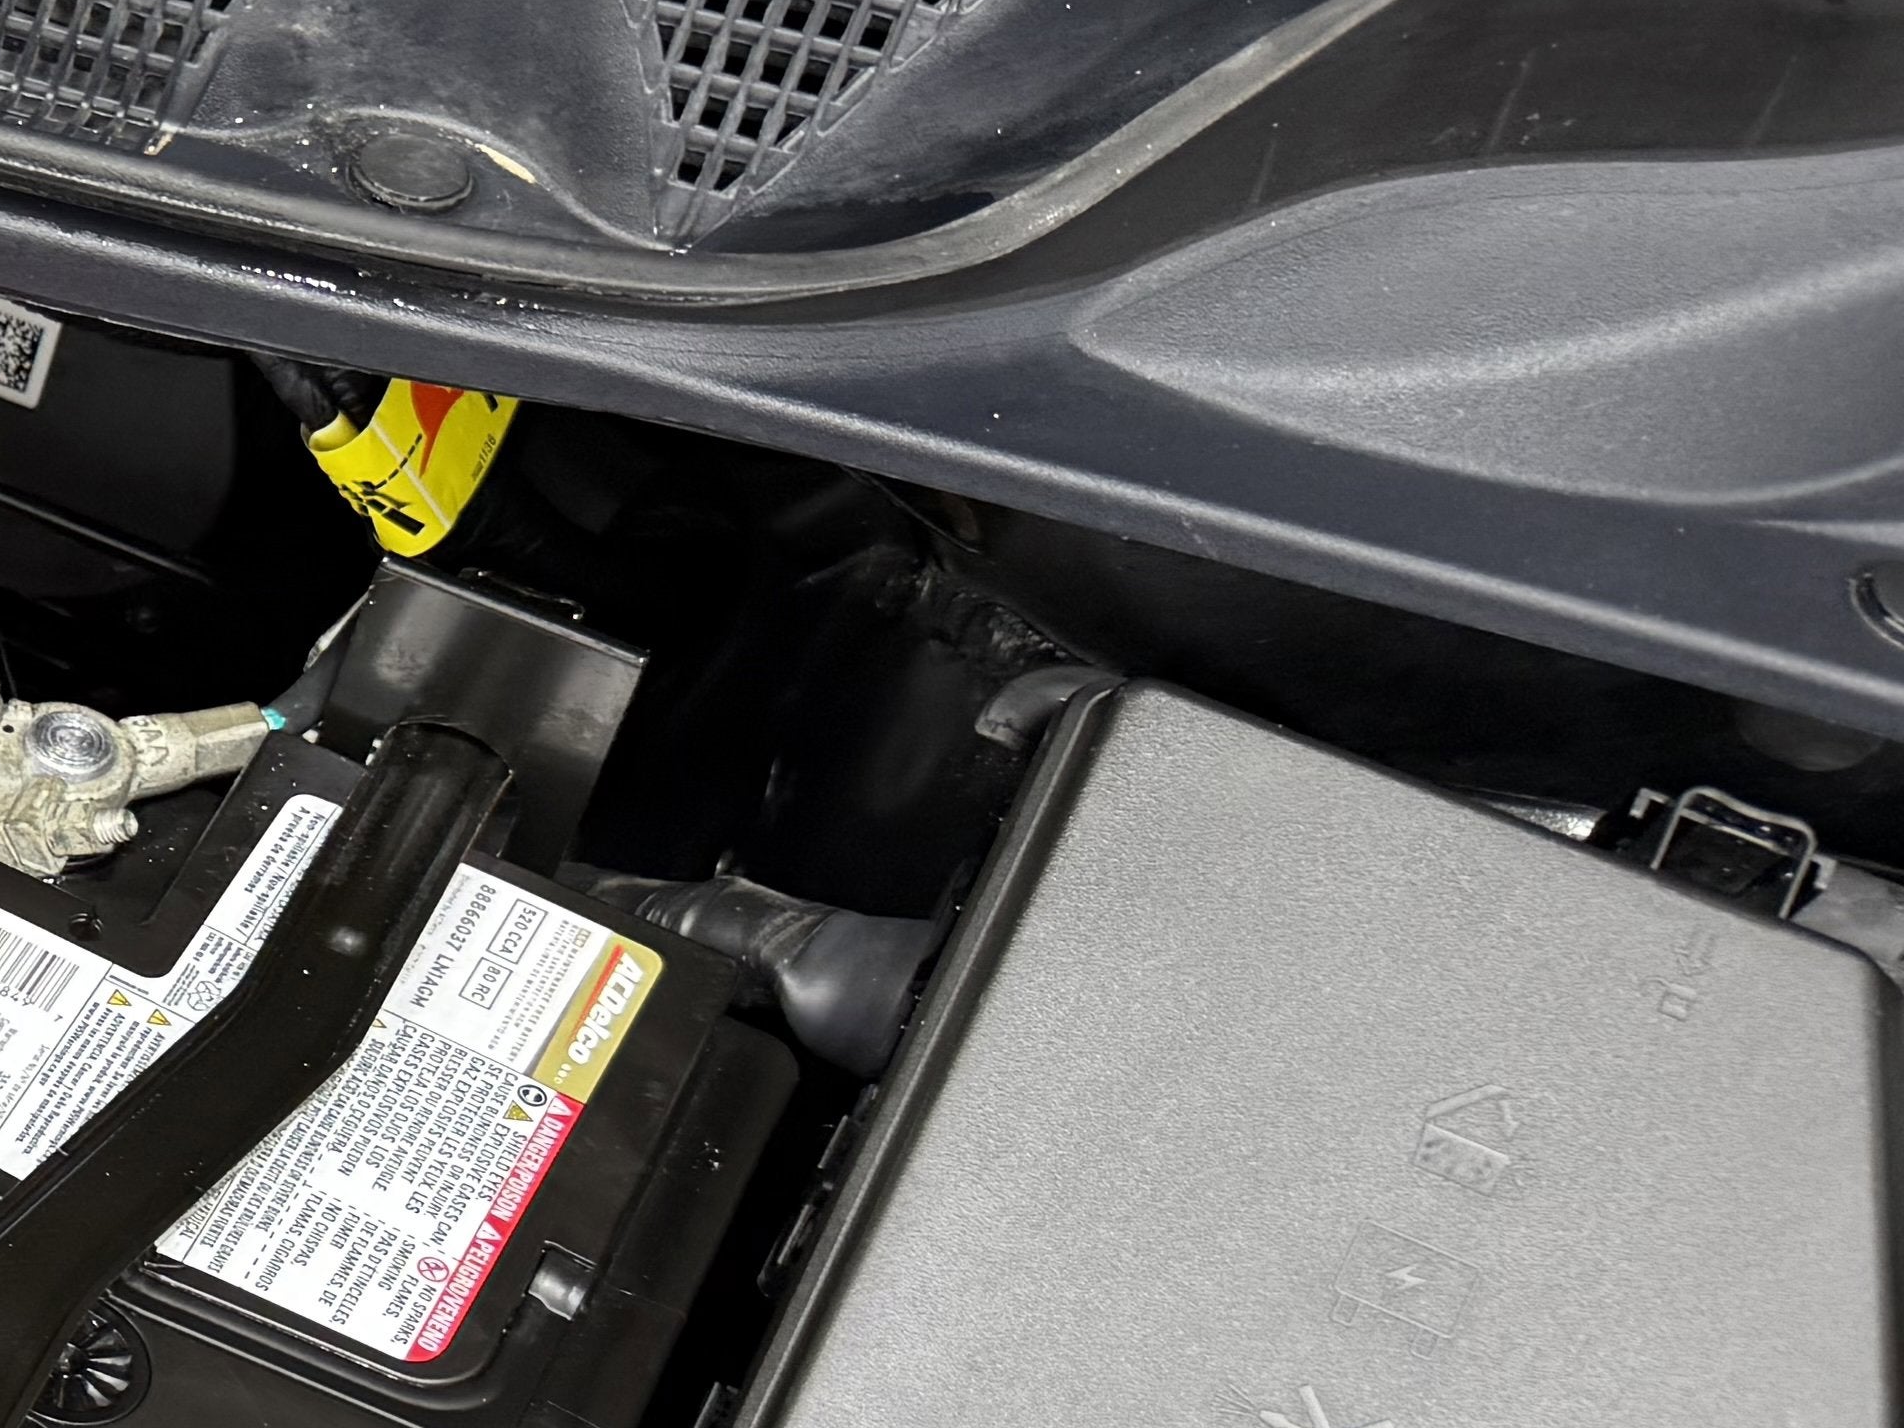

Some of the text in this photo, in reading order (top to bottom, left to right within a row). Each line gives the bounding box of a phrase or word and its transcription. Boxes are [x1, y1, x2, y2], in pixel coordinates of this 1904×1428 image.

[243, 853, 277, 896] derrames
[444, 883, 497, 952] 88866037
[498, 906, 536, 956] 520 CCA
[408, 952, 454, 1009] LN1AGM
[470, 965, 500, 1002] 80 RC
[563, 950, 648, 1069] ACDelco
[382, 1023, 418, 1065] CAUSAR
[402, 1031, 436, 1069] GASES
[411, 1039, 453, 1090] PROTEJA
[432, 1047, 468, 1091] BLESSER
[483, 1063, 503, 1080] SE
[489, 1071, 518, 1106] CAUSE
[355, 1098, 371, 1109] O
[361, 1068, 413, 1136] EXPLOSIVOS
[398, 1088, 423, 1112] LOS
[398, 1055, 486, 1183] GAZ EXPLOSIFS PEUVENT
[423, 1090, 442, 1107] OU
[399, 1105, 433, 1146] RENDRE
[436, 1136, 460, 1159] LES
[456, 1105, 499, 1162] BLINDNESS
[336, 1134, 372, 1176] PUEDEN
[364, 1144, 389, 1168] LOS
[445, 1163, 464, 1180] OR
[475, 1130, 528, 1204] SHIELD EYES.
[403, 1190, 428, 1214] LES
[428, 1122, 510, 1245] EXPLOSIVE GASES CAN
[289, 1202, 342, 1269] NO CHISPAS,
[328, 1212, 361, 1249] FUMER
[372, 1230, 397, 1255] PAS
[414, 1114, 565, 1354] DANGER/POISON PELIGRO/VENENO
[252, 1237, 296, 1291] CIGARROS
[317, 1220, 379, 1306] DE FLAMMES, DE
[376, 1239, 416, 1291] SMOKING
[382, 1273, 420, 1320] FLAMES,
[390, 1283, 437, 1347] NO SPARKS,
